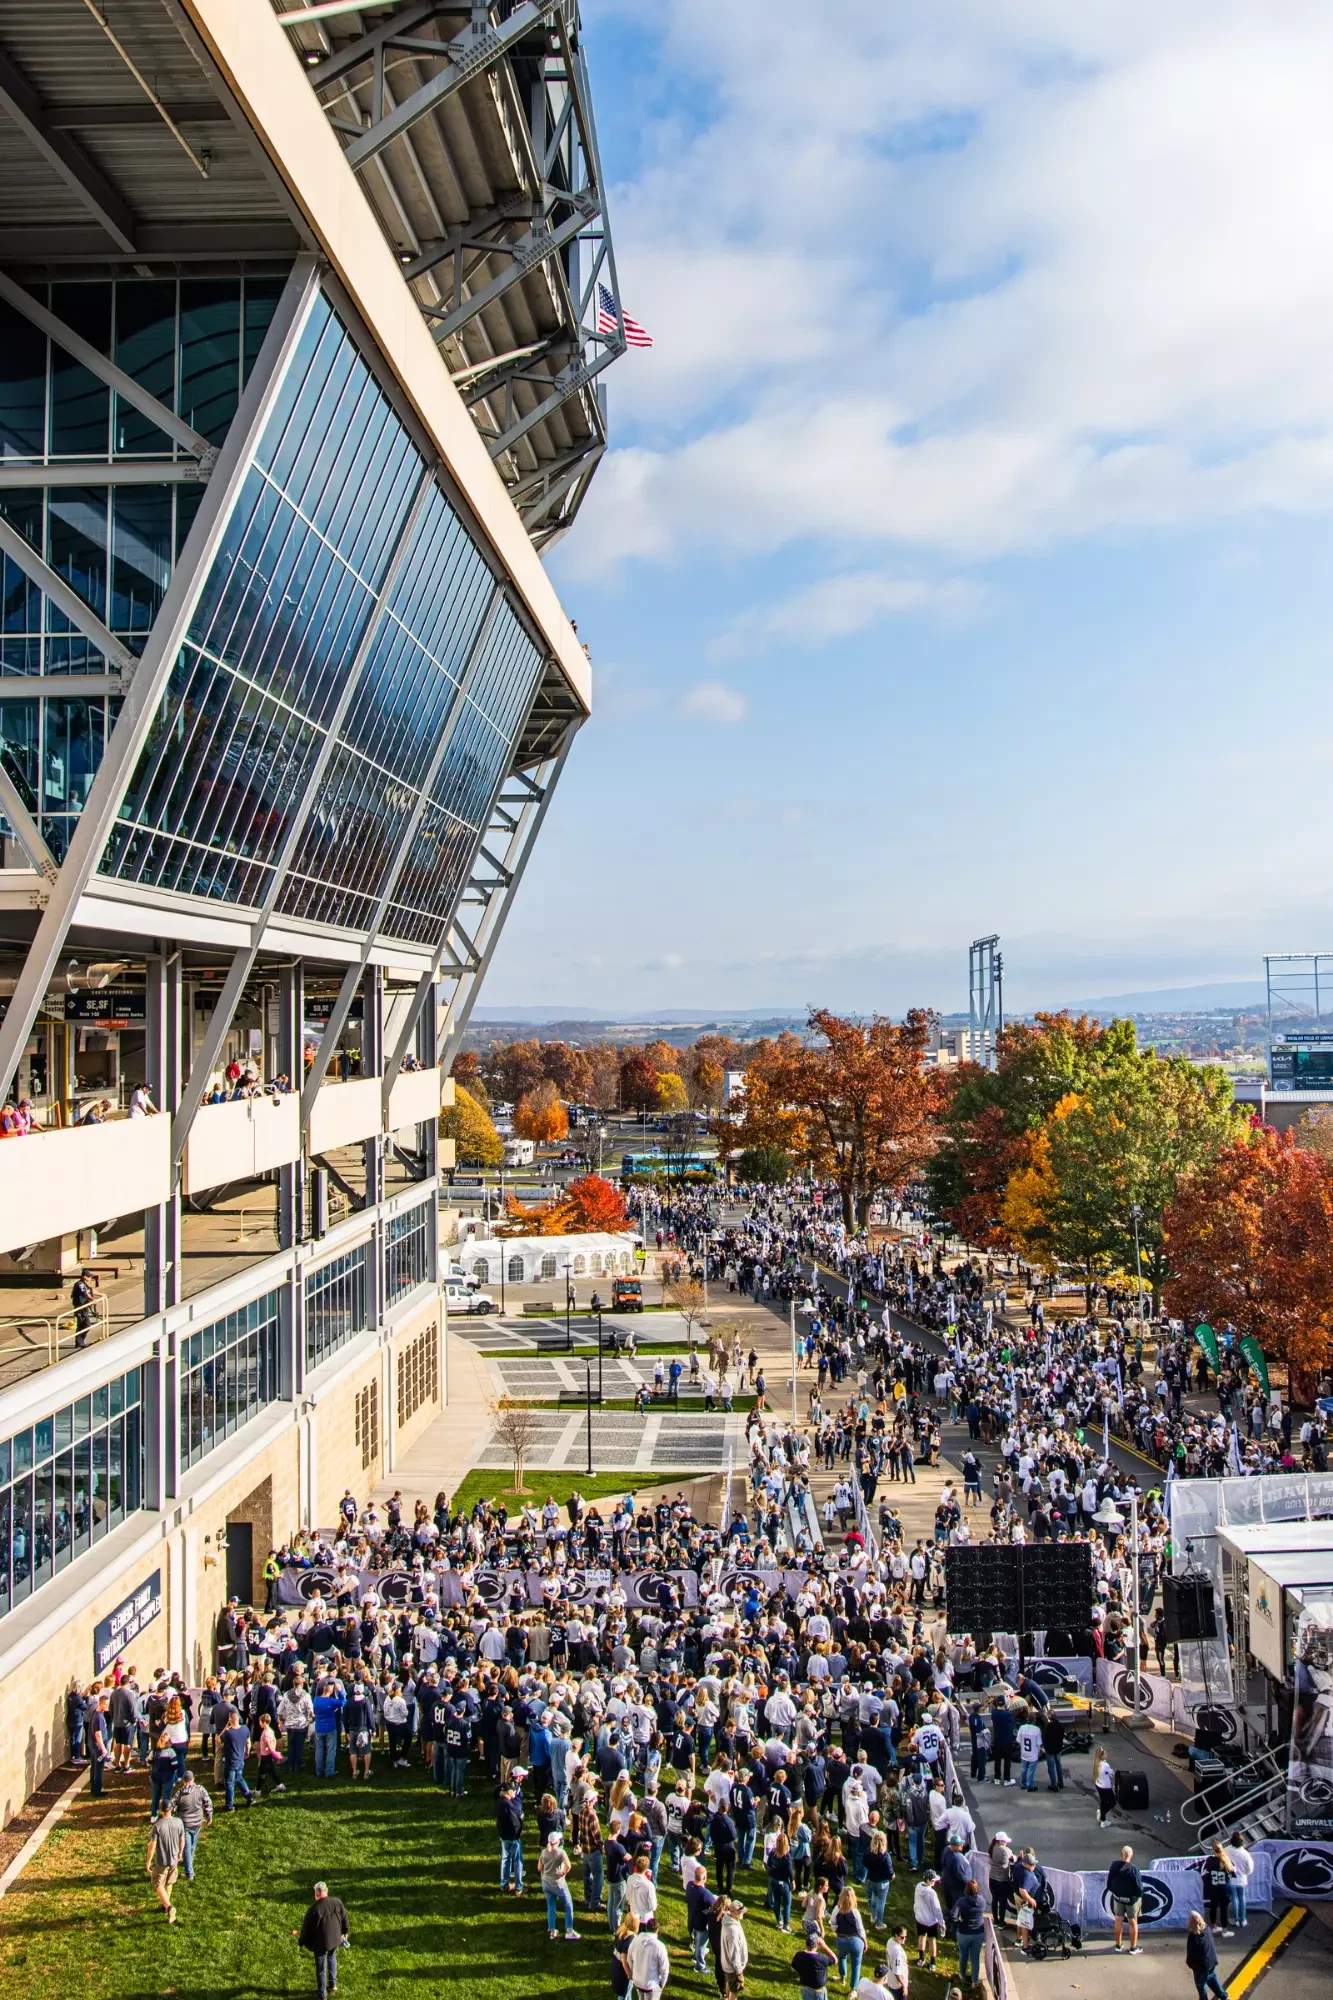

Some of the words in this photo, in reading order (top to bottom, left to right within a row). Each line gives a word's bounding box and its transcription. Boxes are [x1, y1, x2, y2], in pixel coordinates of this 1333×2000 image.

[86, 1000, 108, 1010] SE,SF
[1196, 1332, 1208, 1352] Uber
[1242, 1344, 1254, 1363] Uber
[1251, 1362, 1263, 1381] Eats
[249, 1634, 260, 1644] 94
[434, 1706, 445, 1724] 81
[632, 1713, 639, 1729] 3
[447, 1730, 461, 1746] 22
[923, 1734, 938, 1749] 26
[1024, 1738, 1032, 1752] 9
[733, 1789, 743, 1809] 14
[770, 1788, 780, 1806] 71
[668, 1803, 682, 1820] 22
